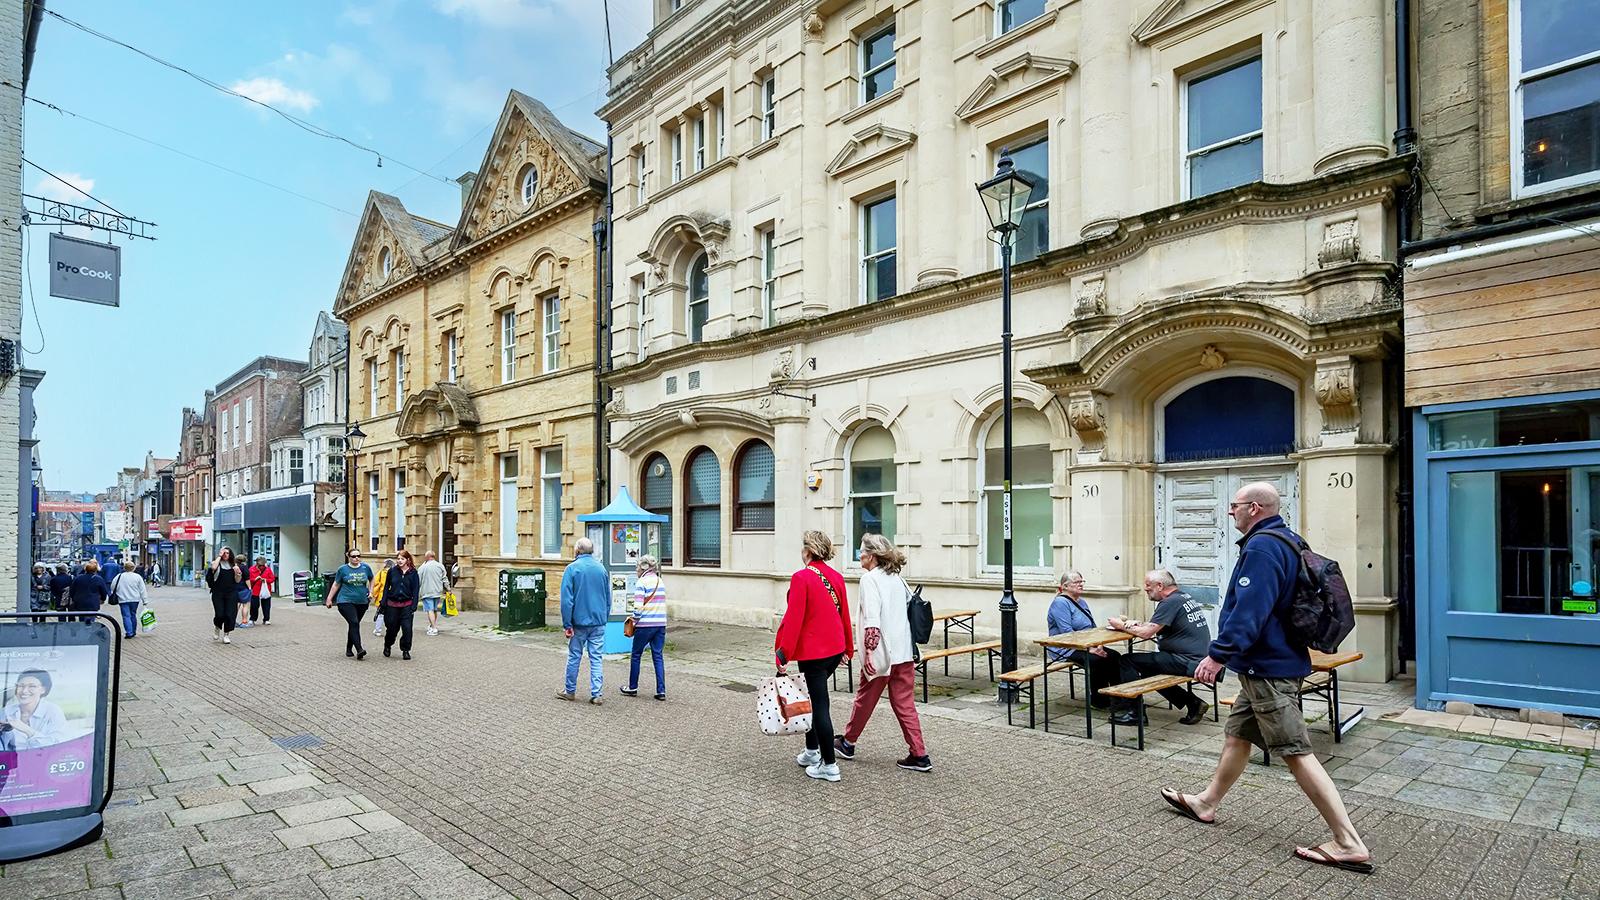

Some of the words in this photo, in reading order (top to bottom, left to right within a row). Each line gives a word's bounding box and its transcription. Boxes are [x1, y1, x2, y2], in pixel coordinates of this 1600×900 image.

[57, 261, 113, 280] ProCook
[1327, 471, 1354, 489] 50
[1081, 485, 1099, 497] 50
[49, 761, 85, 774] £5.70
